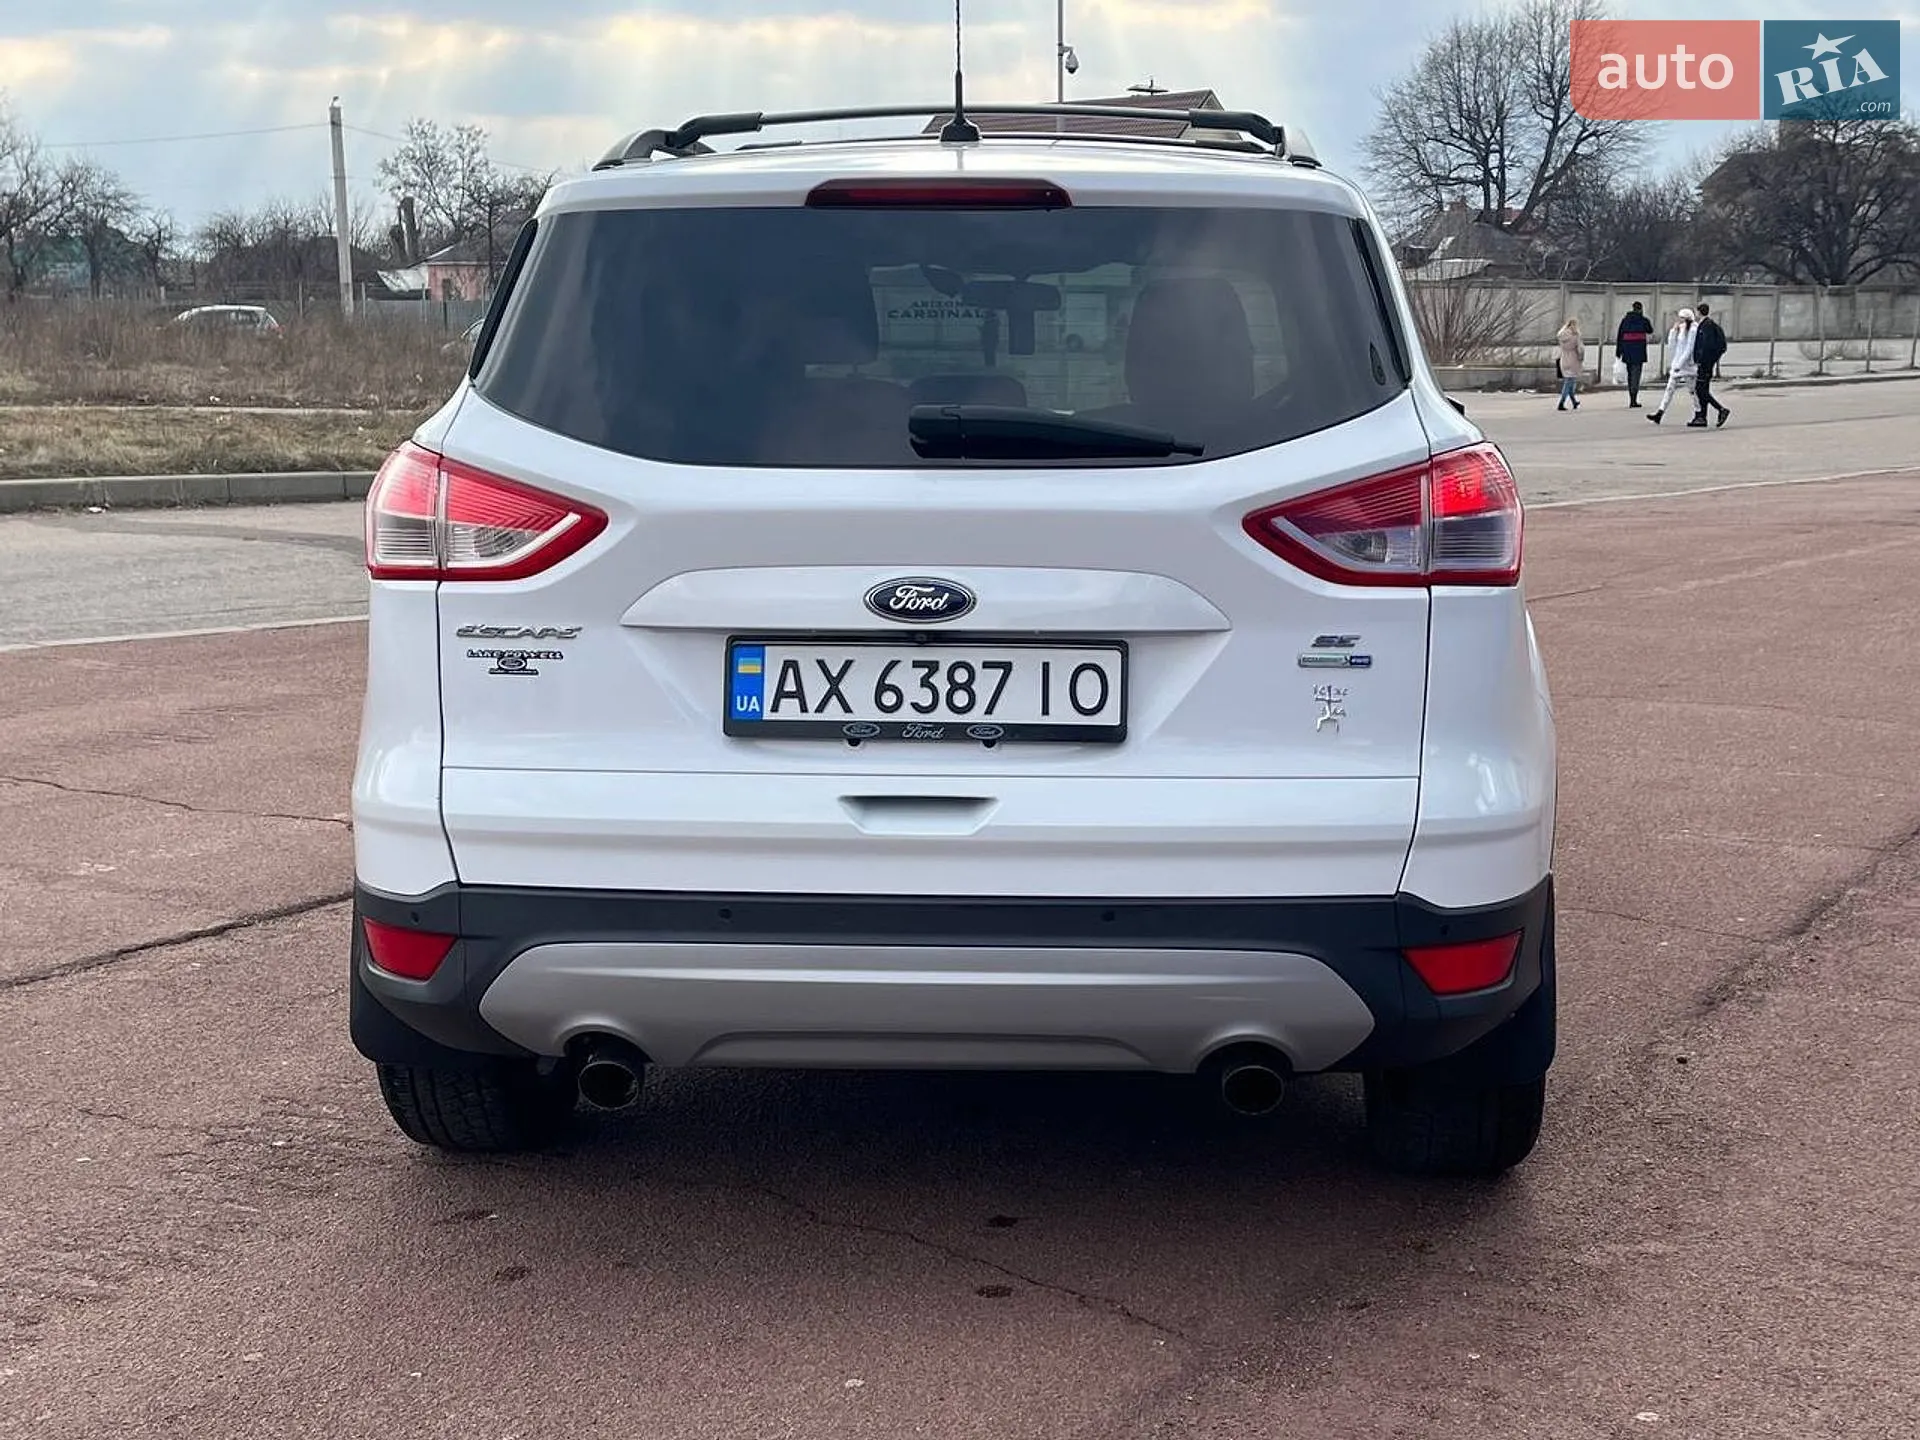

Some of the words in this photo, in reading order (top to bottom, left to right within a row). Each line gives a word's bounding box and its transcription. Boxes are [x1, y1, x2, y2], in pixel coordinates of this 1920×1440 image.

[736, 695, 760, 712] UA
[770, 659, 854, 714] AX
[874, 659, 1013, 715] 6387
[1041, 660, 1109, 716] IO
[902, 723, 946, 739] Ford
